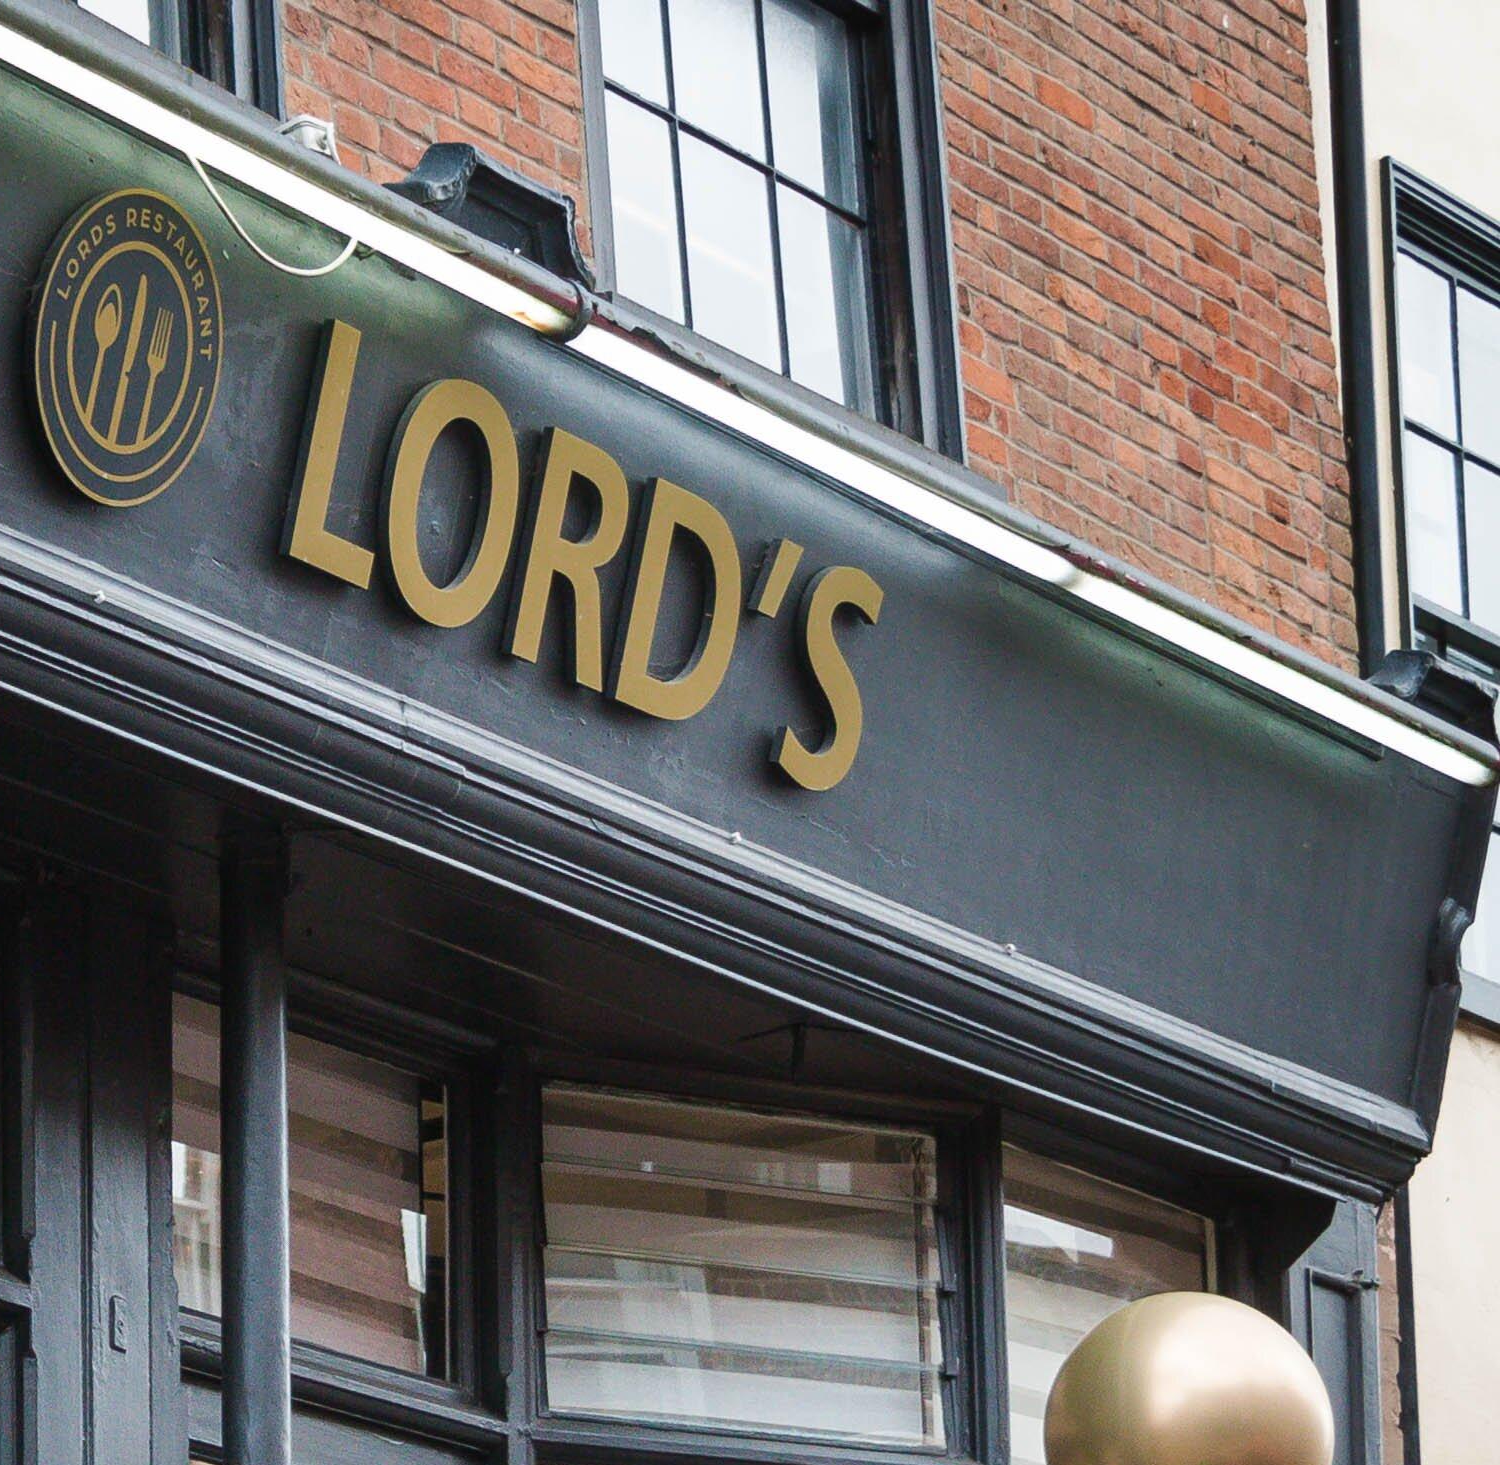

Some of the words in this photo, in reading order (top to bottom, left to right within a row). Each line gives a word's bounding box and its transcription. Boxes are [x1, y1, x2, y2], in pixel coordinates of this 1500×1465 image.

[57, 213, 117, 302] LORDS
[127, 207, 213, 361] RESTAURANT
[283, 318, 885, 791] LORD'S
